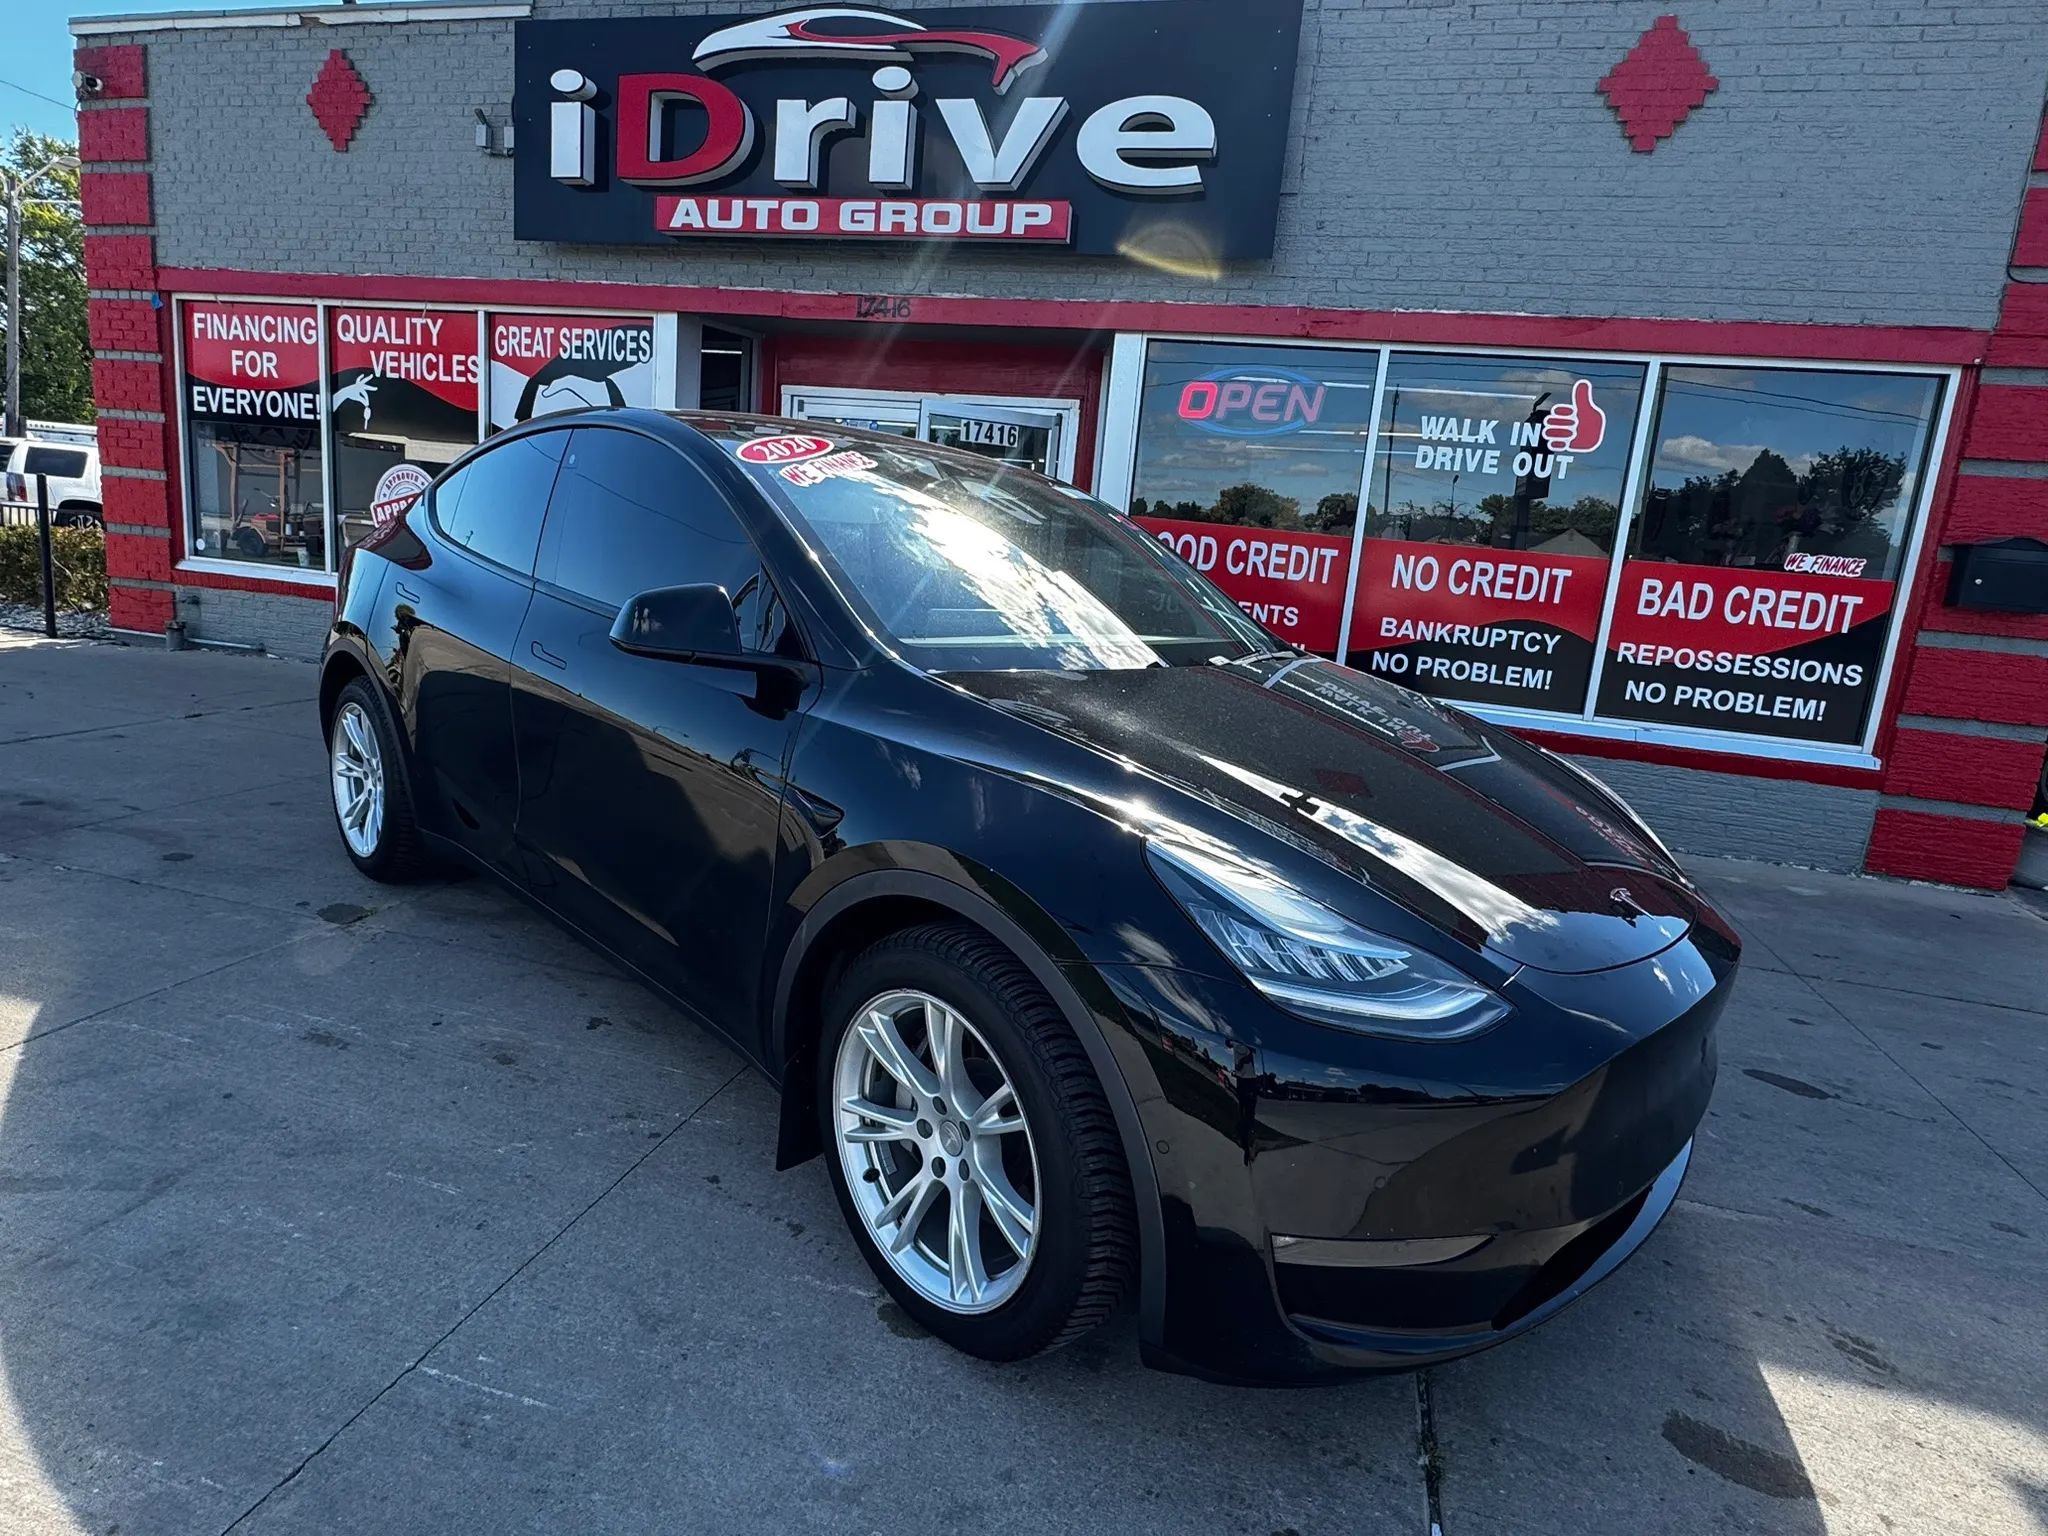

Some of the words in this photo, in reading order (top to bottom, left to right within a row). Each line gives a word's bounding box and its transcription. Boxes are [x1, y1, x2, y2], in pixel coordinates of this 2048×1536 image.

[550, 66, 1217, 193] iDrive
[668, 198, 820, 231] AUTO
[839, 200, 1053, 235] GROUP
[193, 313, 317, 346] FINANCING
[336, 313, 444, 347] QUALITY
[494, 325, 554, 359] GREAT
[559, 327, 652, 363] SERVICES
[231, 350, 279, 379] FOR
[369, 350, 480, 384] VEHICLES
[192, 386, 322, 420] EVERYONE!
[1178, 381, 1326, 423] OPEN
[752, 436, 818, 462] 2020
[963, 420, 1018, 446] 17416
[1421, 415, 1499, 445] WALK
[1509, 421, 1542, 447] IN
[781, 465, 818, 485] WE
[1415, 445, 1500, 474] DRIVE
[1512, 451, 1574, 480] OUT
[1226, 538, 1339, 584] CREDIT
[1391, 554, 1440, 592] NO
[1448, 559, 1573, 604] CREDIT
[1785, 554, 1809, 569] WE
[1809, 555, 1866, 576] FINANCE
[1637, 578, 1714, 620] BAD
[1723, 586, 1864, 634] CREDIT
[1380, 616, 1561, 655] BANKRUPTCY
[1371, 650, 1409, 674] NO
[1416, 656, 1553, 691] PROBLEM!
[1617, 642, 1863, 686] REPOSSESSIONS
[1624, 680, 1666, 704] NO
[1673, 685, 1827, 722] PROBLEM!
